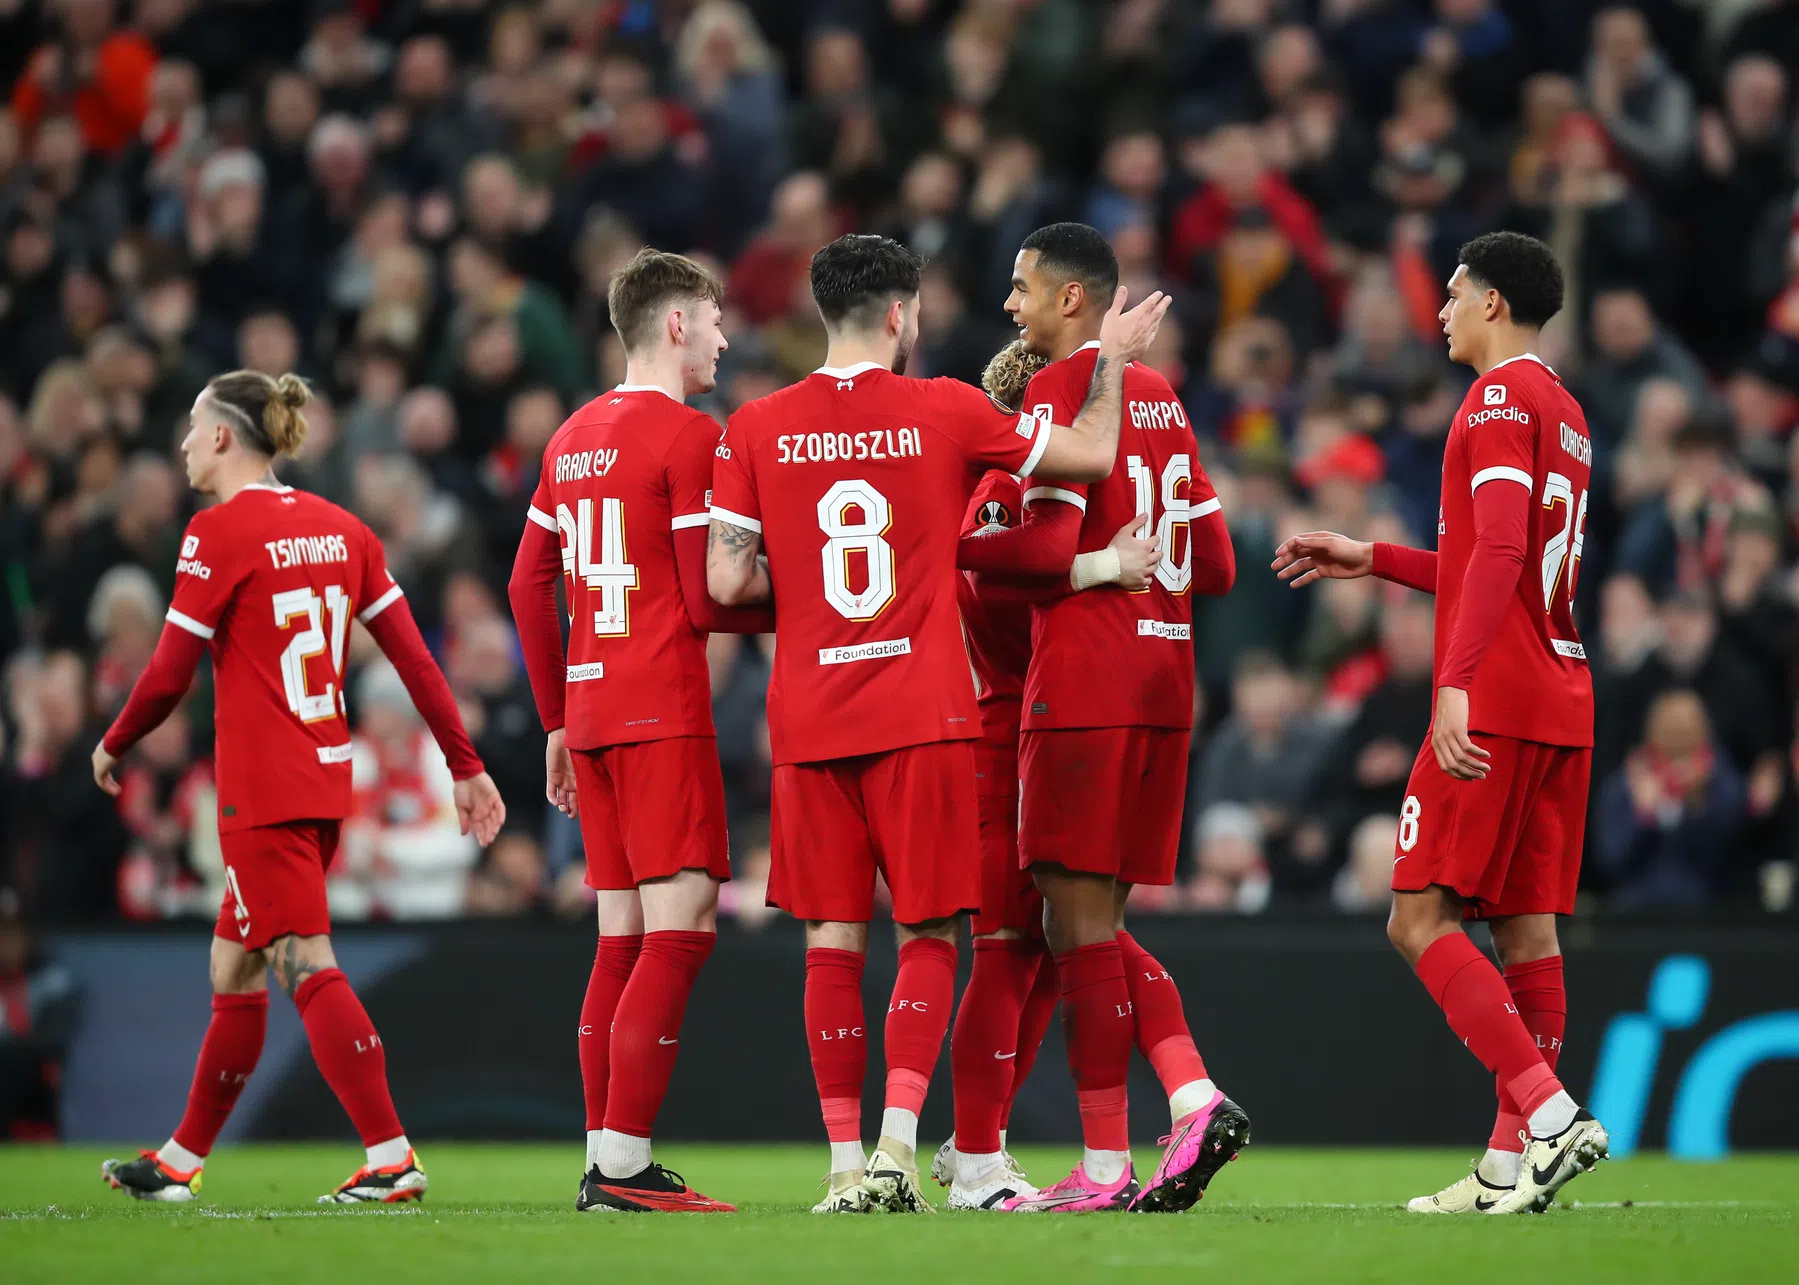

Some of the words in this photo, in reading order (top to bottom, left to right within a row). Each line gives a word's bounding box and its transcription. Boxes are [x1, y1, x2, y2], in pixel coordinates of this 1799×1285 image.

[1129, 400, 1186, 430] GAKPO
[1467, 406, 1529, 428] Expedia
[777, 427, 922, 464] SZOBOSZLAI
[556, 448, 619, 484] BRADLEY
[1126, 454, 1192, 596] 18
[265, 535, 348, 569] TSIMIKAS
[817, 479, 897, 623] 8
[272, 585, 352, 724] 21
[835, 643, 906, 660] Foundation
[1399, 795, 1422, 853] 8
[886, 1000, 928, 1014] LFC
[354, 1034, 382, 1053] LF
[821, 1027, 863, 1041] LFC
